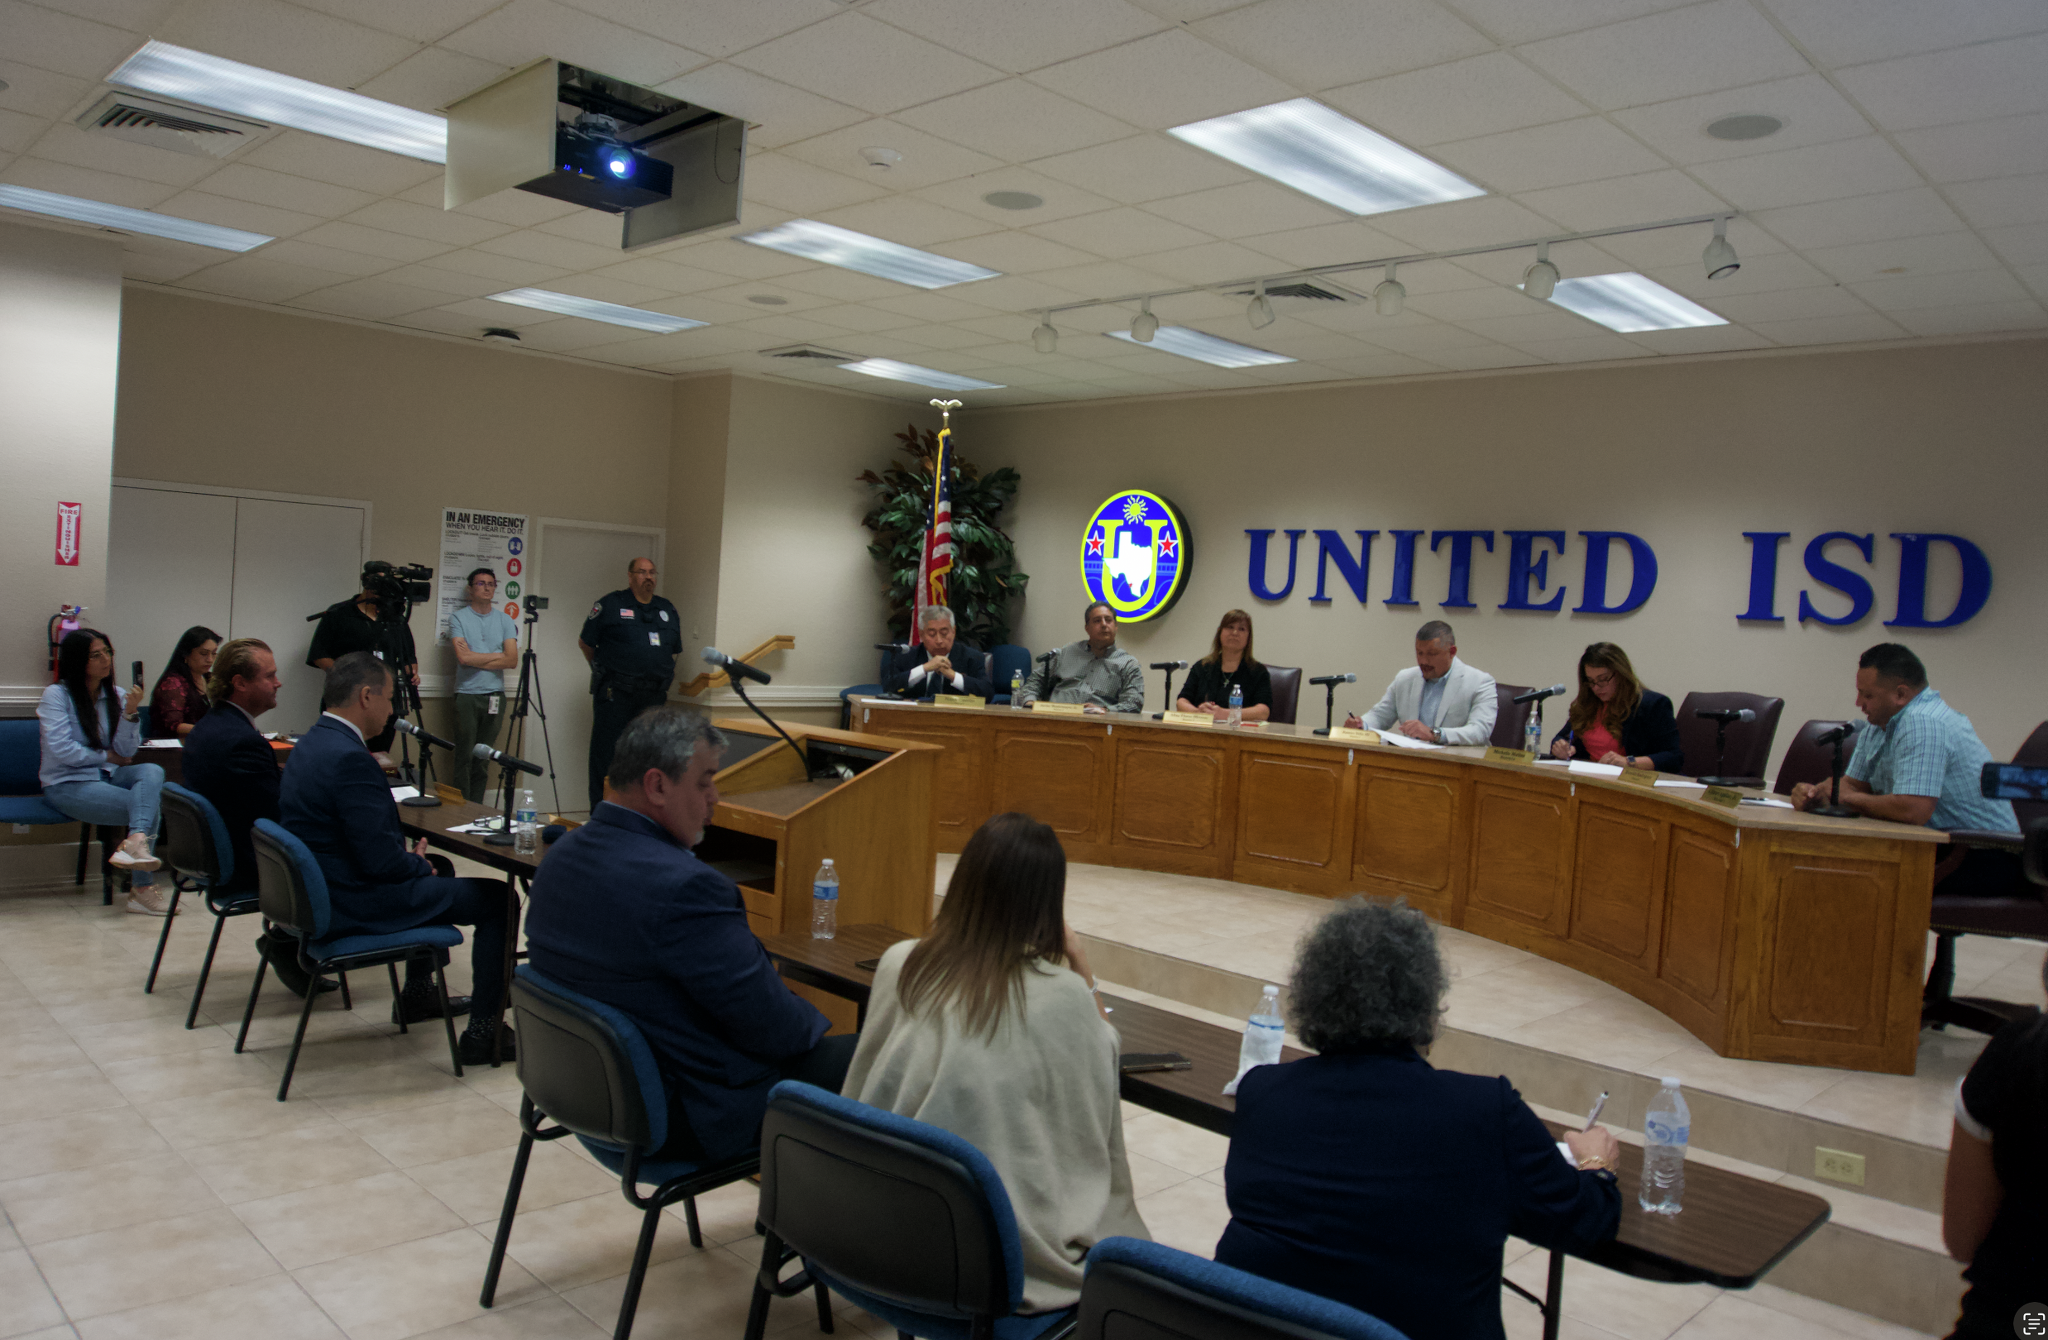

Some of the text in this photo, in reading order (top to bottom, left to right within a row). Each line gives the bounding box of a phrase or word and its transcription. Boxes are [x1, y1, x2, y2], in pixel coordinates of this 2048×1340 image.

[446, 512, 525, 528] IN AN EMERGENCY
[1244, 529, 1994, 628] UNITED ISD
